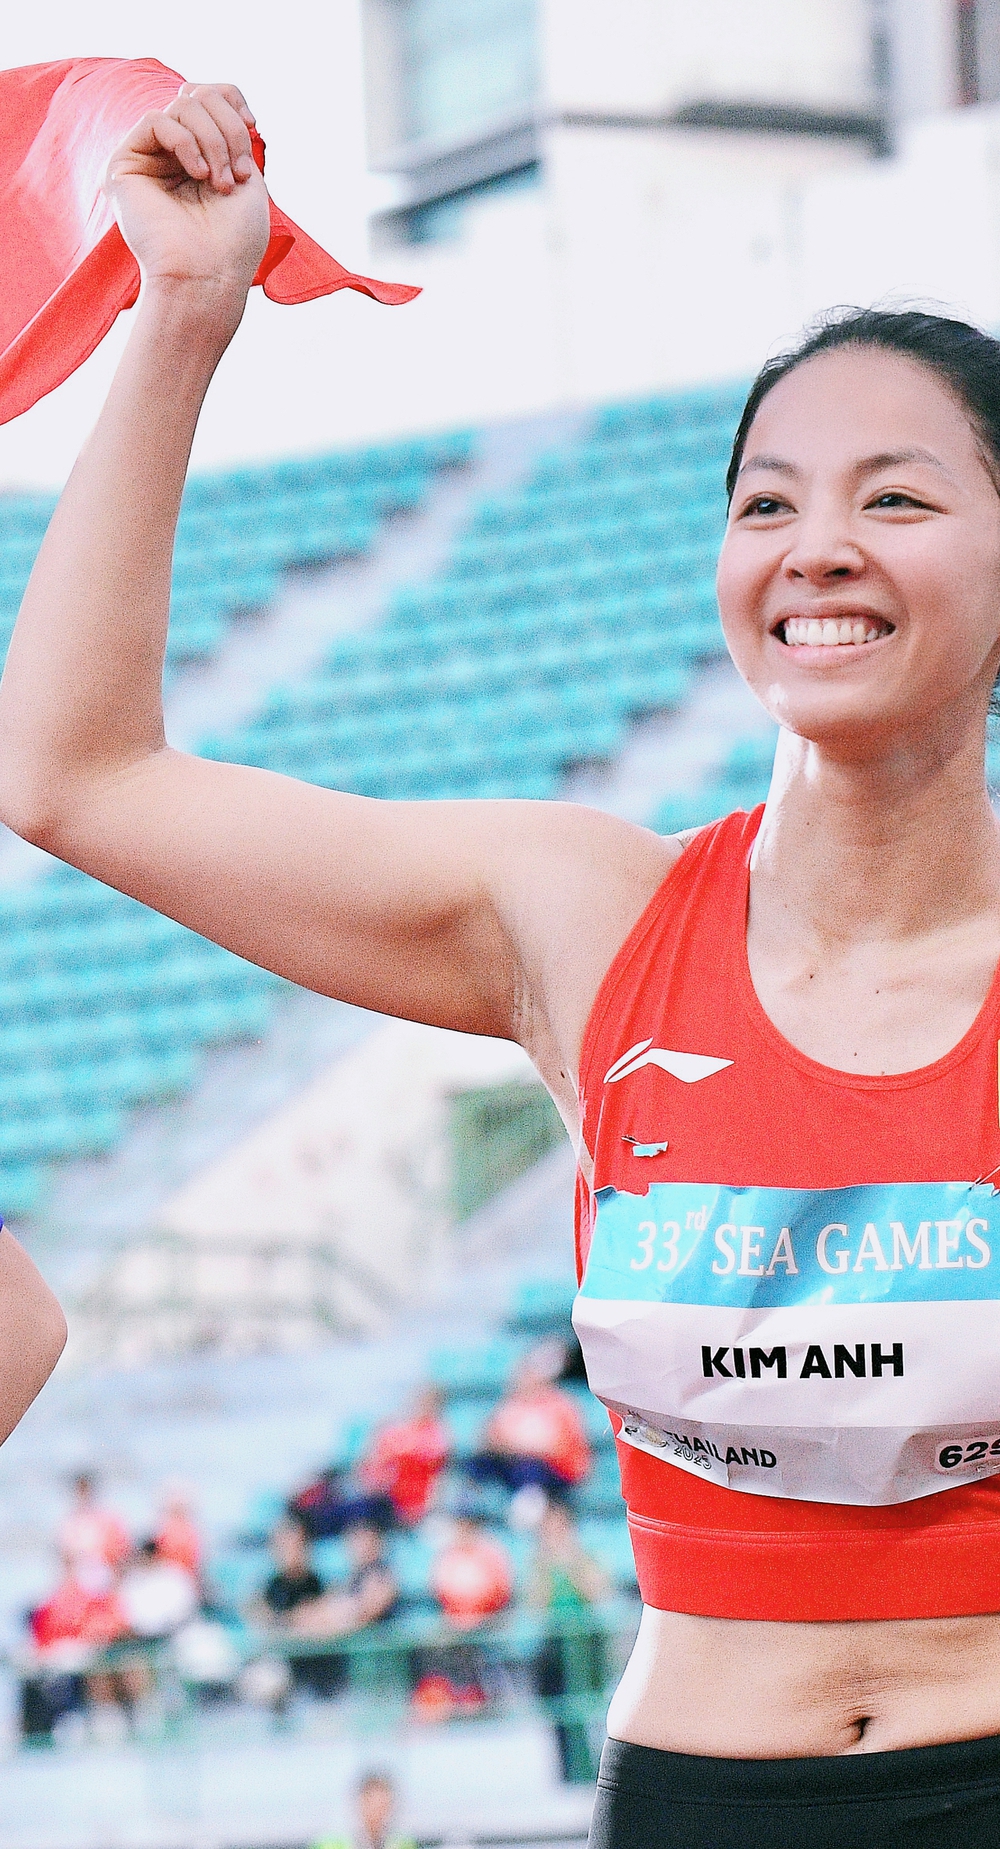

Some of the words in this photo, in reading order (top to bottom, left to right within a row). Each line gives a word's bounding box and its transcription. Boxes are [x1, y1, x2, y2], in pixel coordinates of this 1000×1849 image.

[630, 1205, 708, 1272] 33rd
[711, 1223, 799, 1276] SEA
[816, 1217, 992, 1275] GAMES
[702, 1345, 787, 1379] KIM
[799, 1343, 904, 1379] ANH
